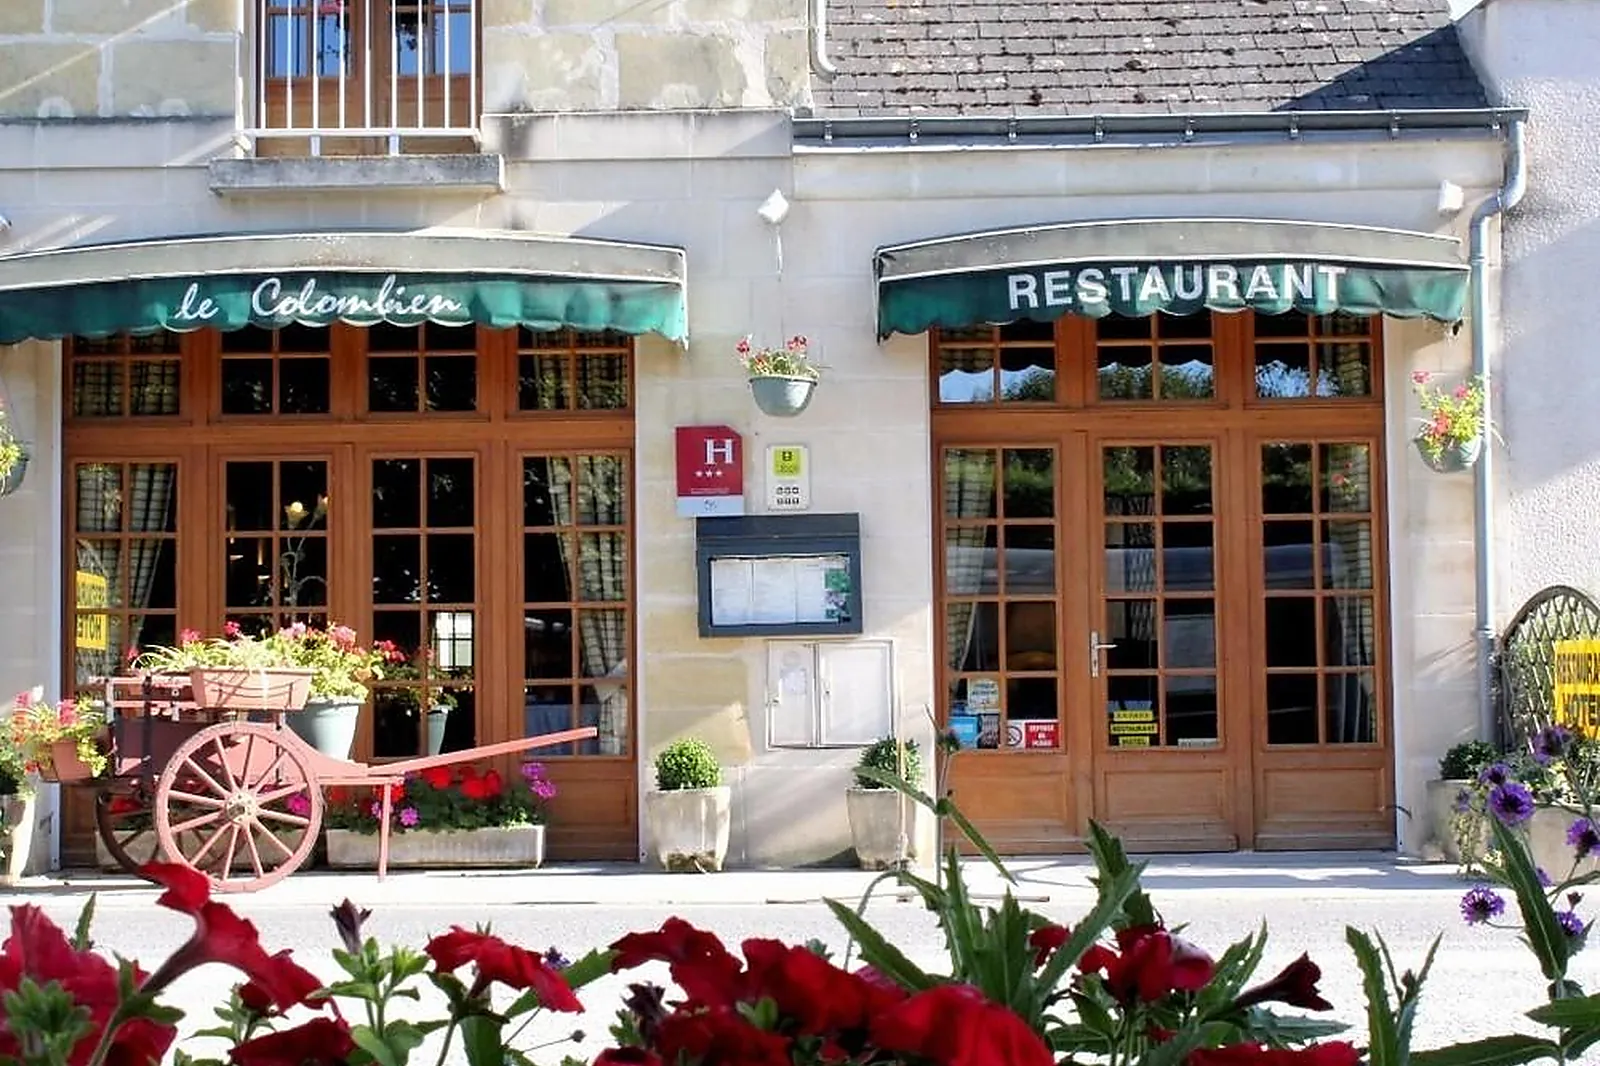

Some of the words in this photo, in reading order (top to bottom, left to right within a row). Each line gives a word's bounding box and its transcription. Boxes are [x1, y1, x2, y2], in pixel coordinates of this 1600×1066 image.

[175, 282, 219, 320] le
[251, 274, 462, 316] Colombien
[1007, 263, 1347, 310] RESTAURANT
[704, 438, 733, 465] H
